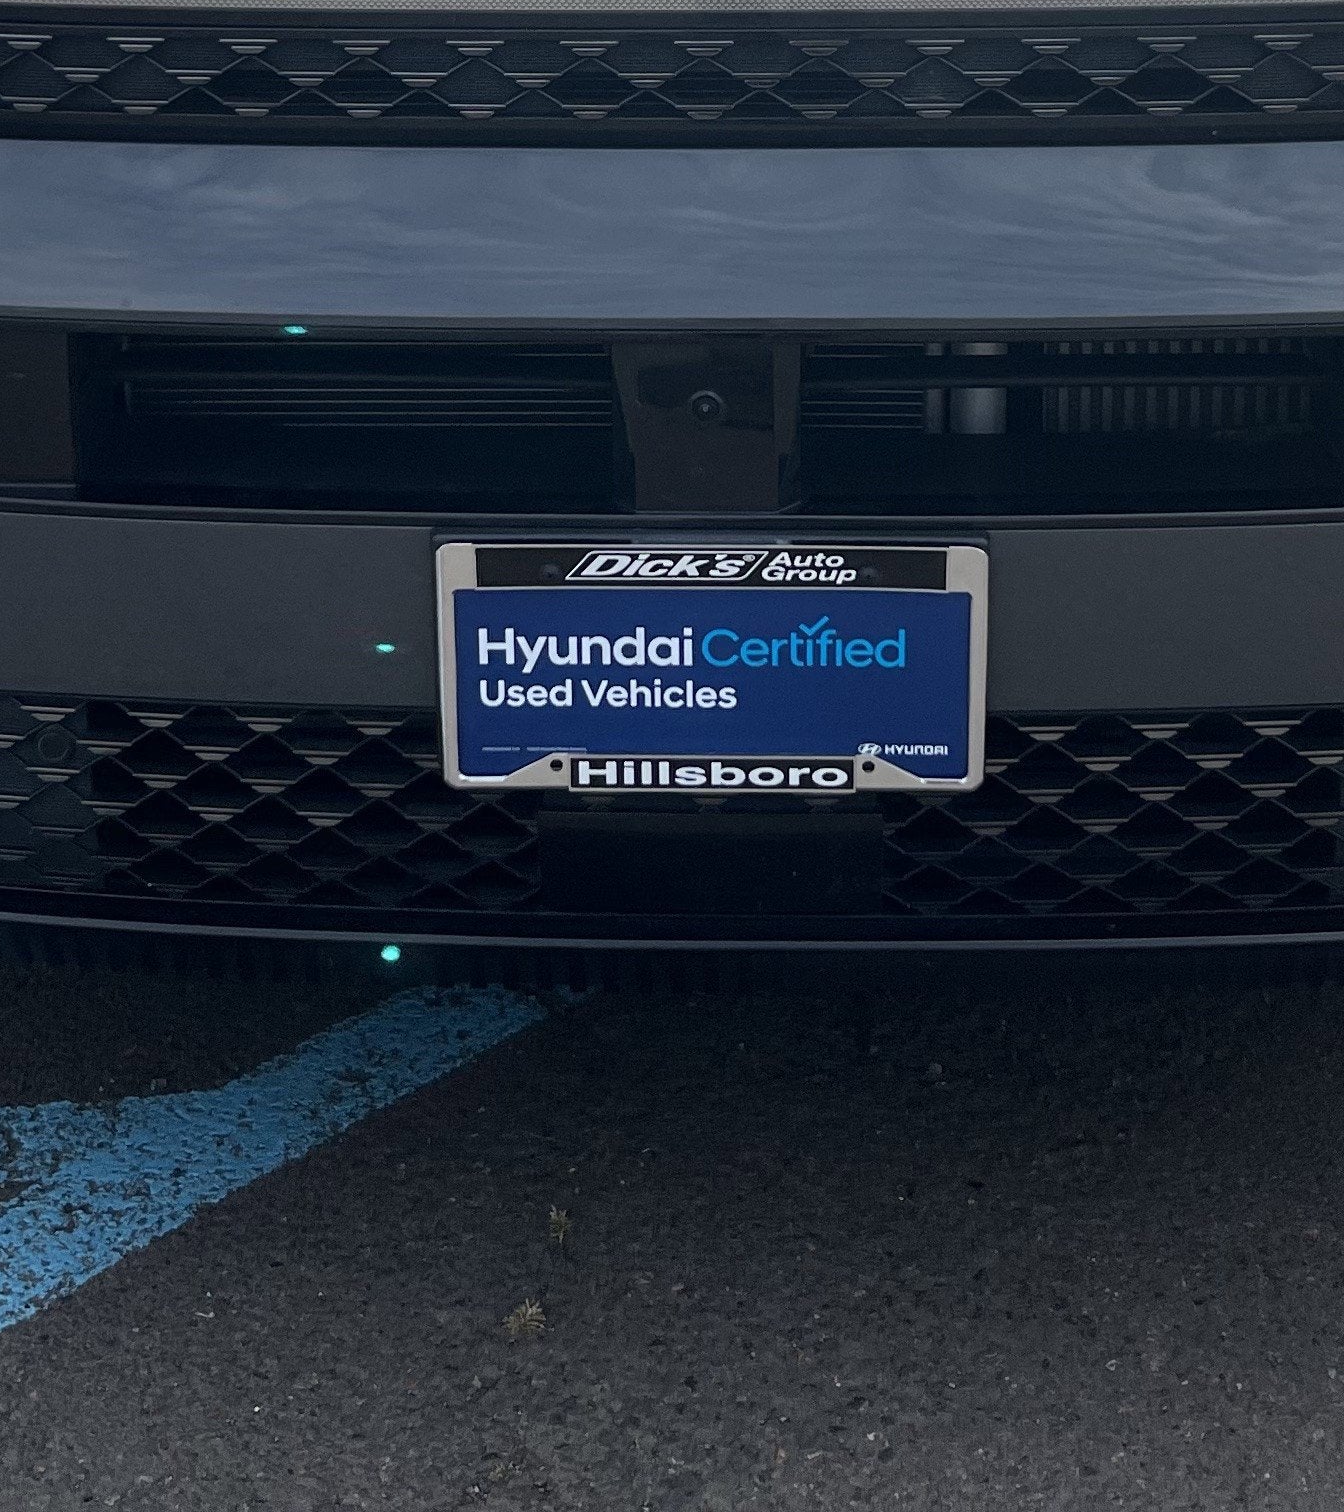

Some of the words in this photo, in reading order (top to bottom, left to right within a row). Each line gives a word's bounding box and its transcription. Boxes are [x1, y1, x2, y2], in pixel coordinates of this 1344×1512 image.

[580, 553, 745, 577] Dick's
[768, 551, 845, 567] Auto
[761, 566, 857, 584] Group
[476, 626, 694, 674] Hyundai
[701, 616, 907, 669] Certified
[478, 679, 573, 708] Used
[582, 679, 738, 709] Vehicles
[884, 744, 949, 757] HYUNDAI
[577, 760, 850, 788] Hillsboro
